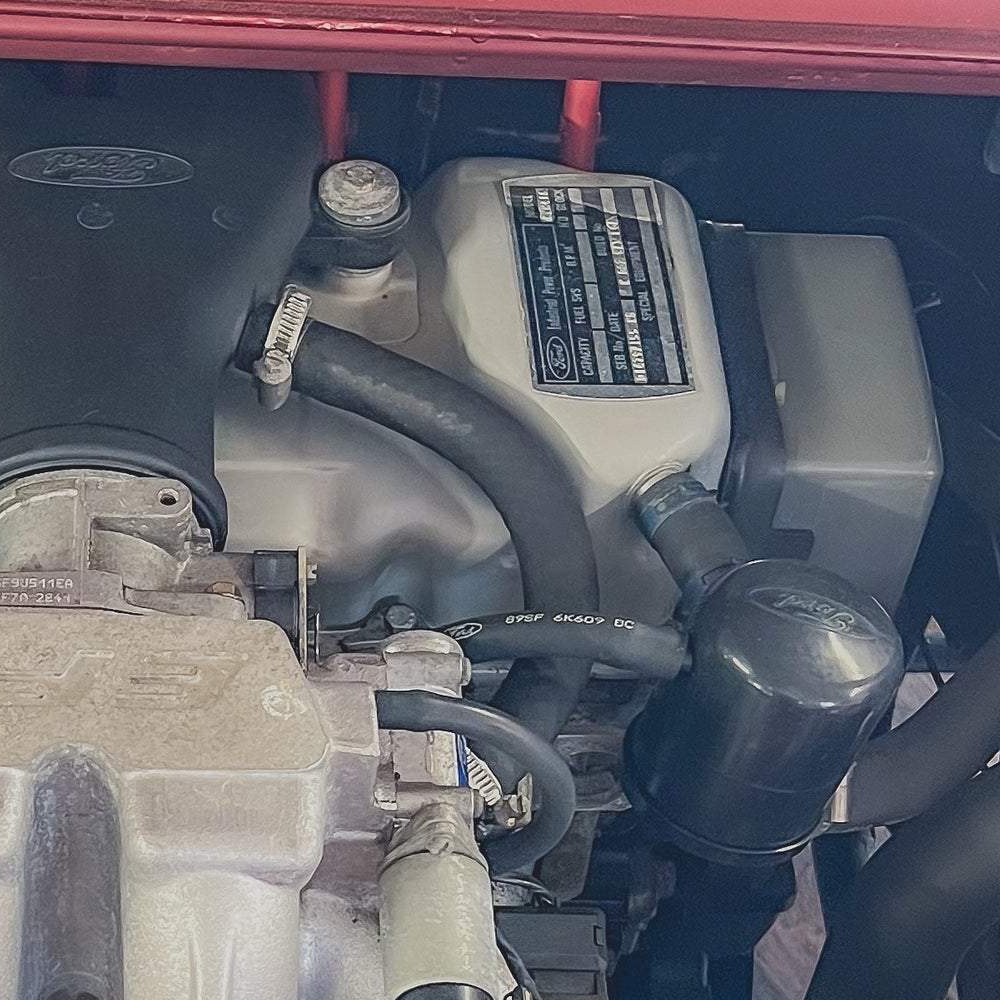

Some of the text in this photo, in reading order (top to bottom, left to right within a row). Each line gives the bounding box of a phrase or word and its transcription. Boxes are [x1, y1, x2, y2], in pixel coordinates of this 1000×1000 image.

[36, 151, 167, 184] Ford
[627, 241, 655, 322] SPECIAL EQUIPMENT
[537, 244, 568, 373] Ford Industrial Power Products
[574, 306, 587, 325] FUEL
[577, 337, 594, 377] CAPACITY
[553, 613, 605, 625] 6K609
[769, 592, 860, 634] Ford
